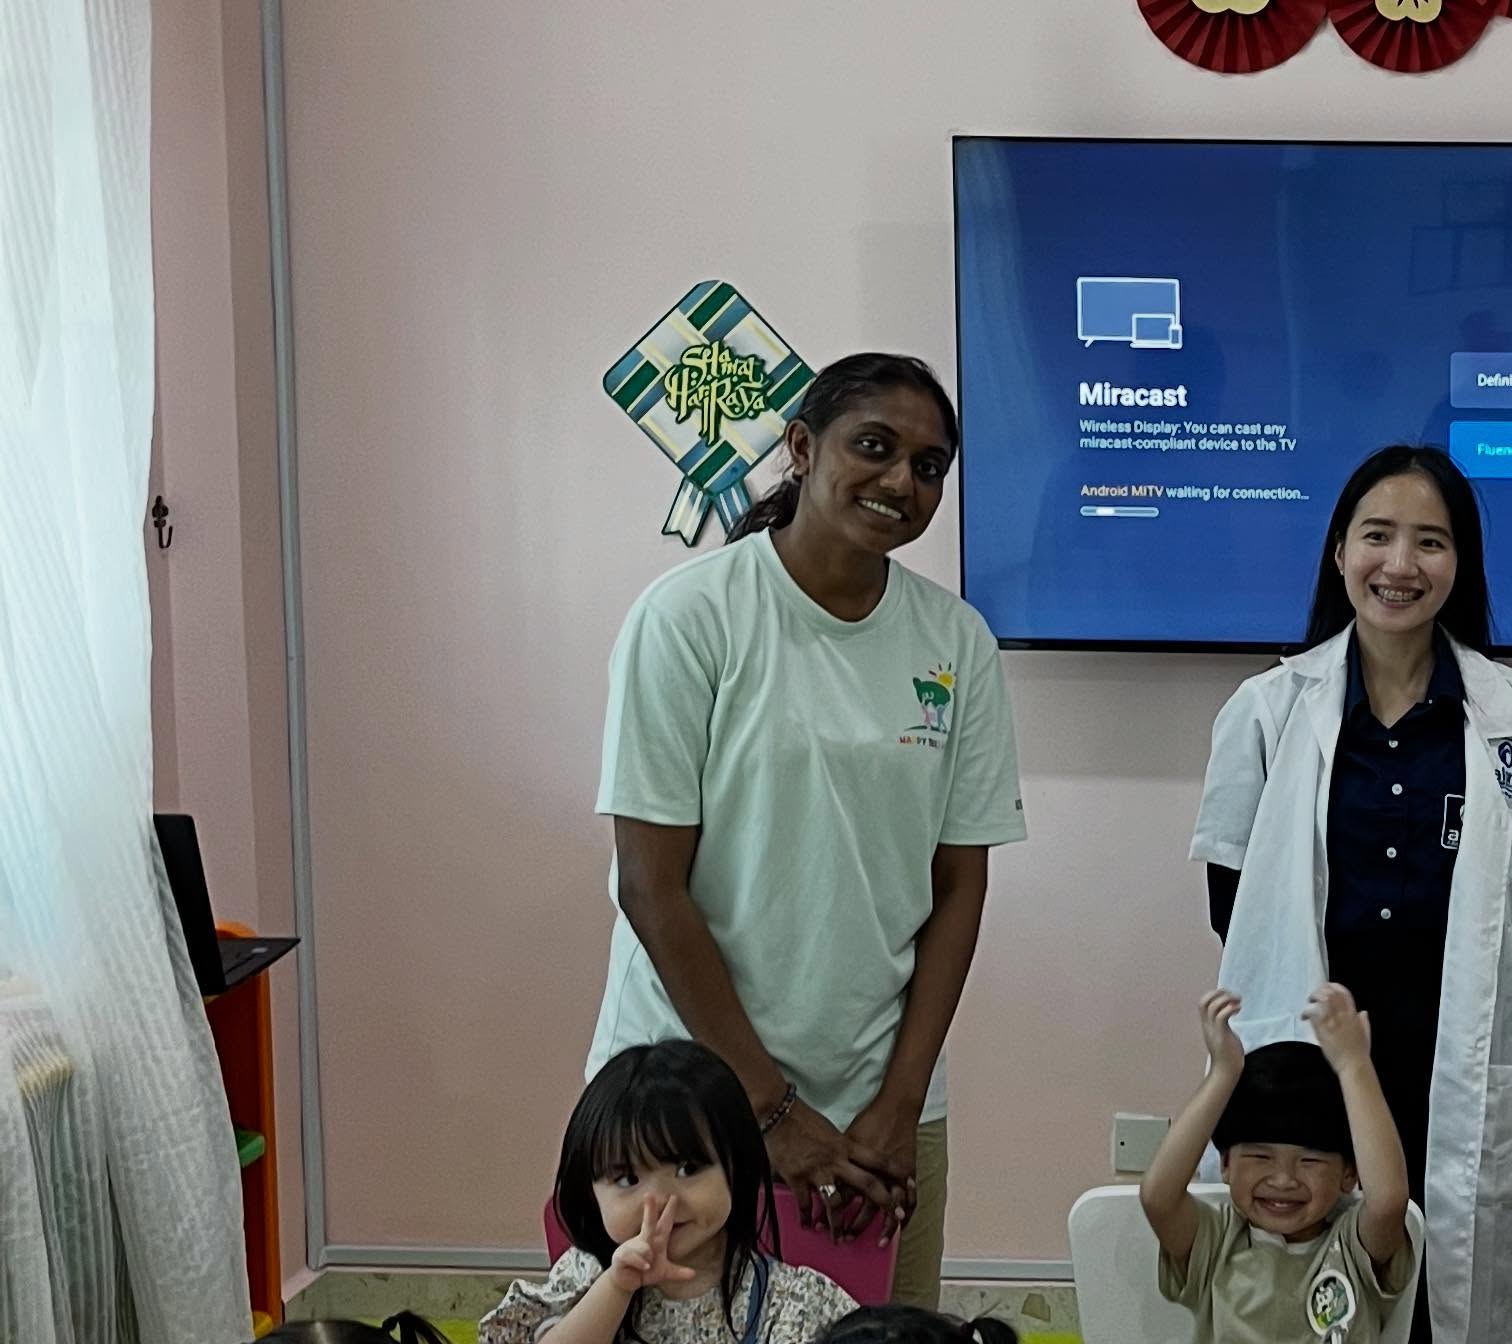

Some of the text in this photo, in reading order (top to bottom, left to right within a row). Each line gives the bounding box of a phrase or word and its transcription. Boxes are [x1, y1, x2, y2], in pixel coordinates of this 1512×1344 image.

[1079, 382, 1188, 407] Miracast
[1079, 419, 1132, 434] Wireless
[1183, 421, 1208, 434] You
[1209, 424, 1233, 435] can
[1234, 422, 1262, 435] cast
[1263, 425, 1287, 438] any
[1079, 436, 1297, 452] miracast-compliant device to the TV
[1080, 485, 1129, 498] Android
[1165, 485, 1211, 501] waiting
[1213, 486, 1231, 500] for
